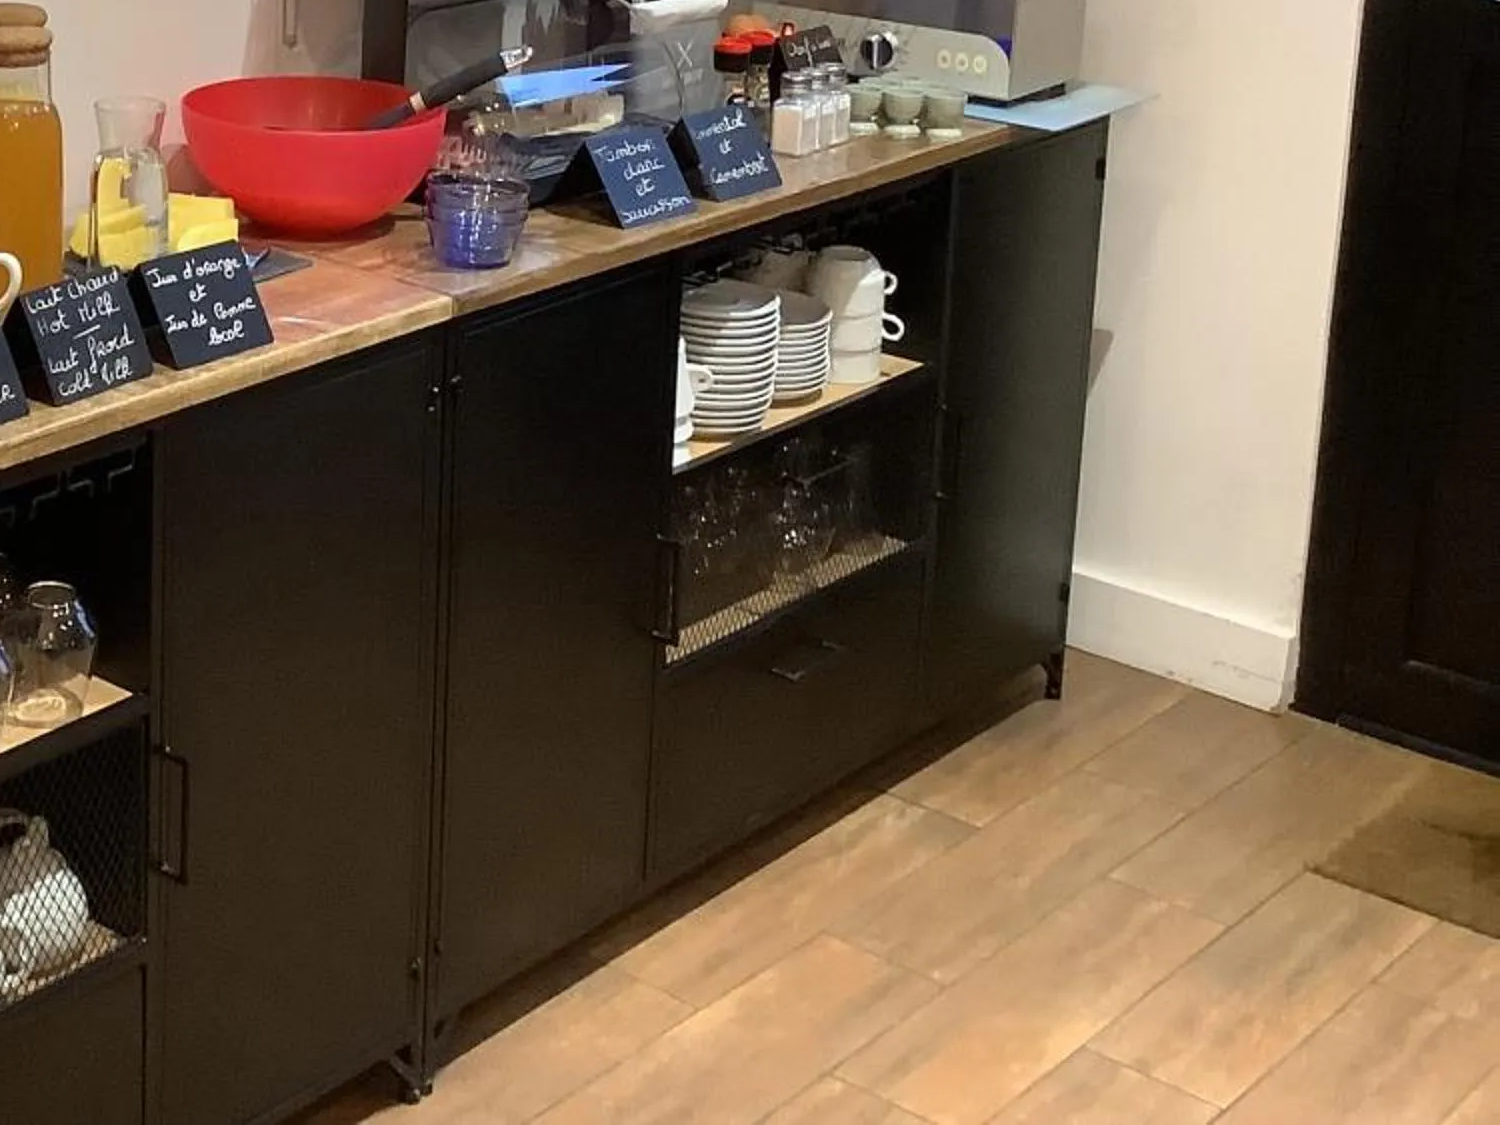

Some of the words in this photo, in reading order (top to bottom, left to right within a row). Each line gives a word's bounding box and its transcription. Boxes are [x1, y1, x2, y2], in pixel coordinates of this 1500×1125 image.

[635, 176, 656, 197] et
[145, 267, 179, 288] Jus
[182, 257, 242, 280] d'orange
[25, 285, 63, 314] Lait
[67, 266, 119, 300] Chaud
[188, 282, 208, 303] et
[36, 308, 71, 336] Hot
[78, 290, 121, 323] Milk
[164, 314, 189, 335] Jus
[190, 309, 208, 328] de
[47, 346, 79, 374] Lait
